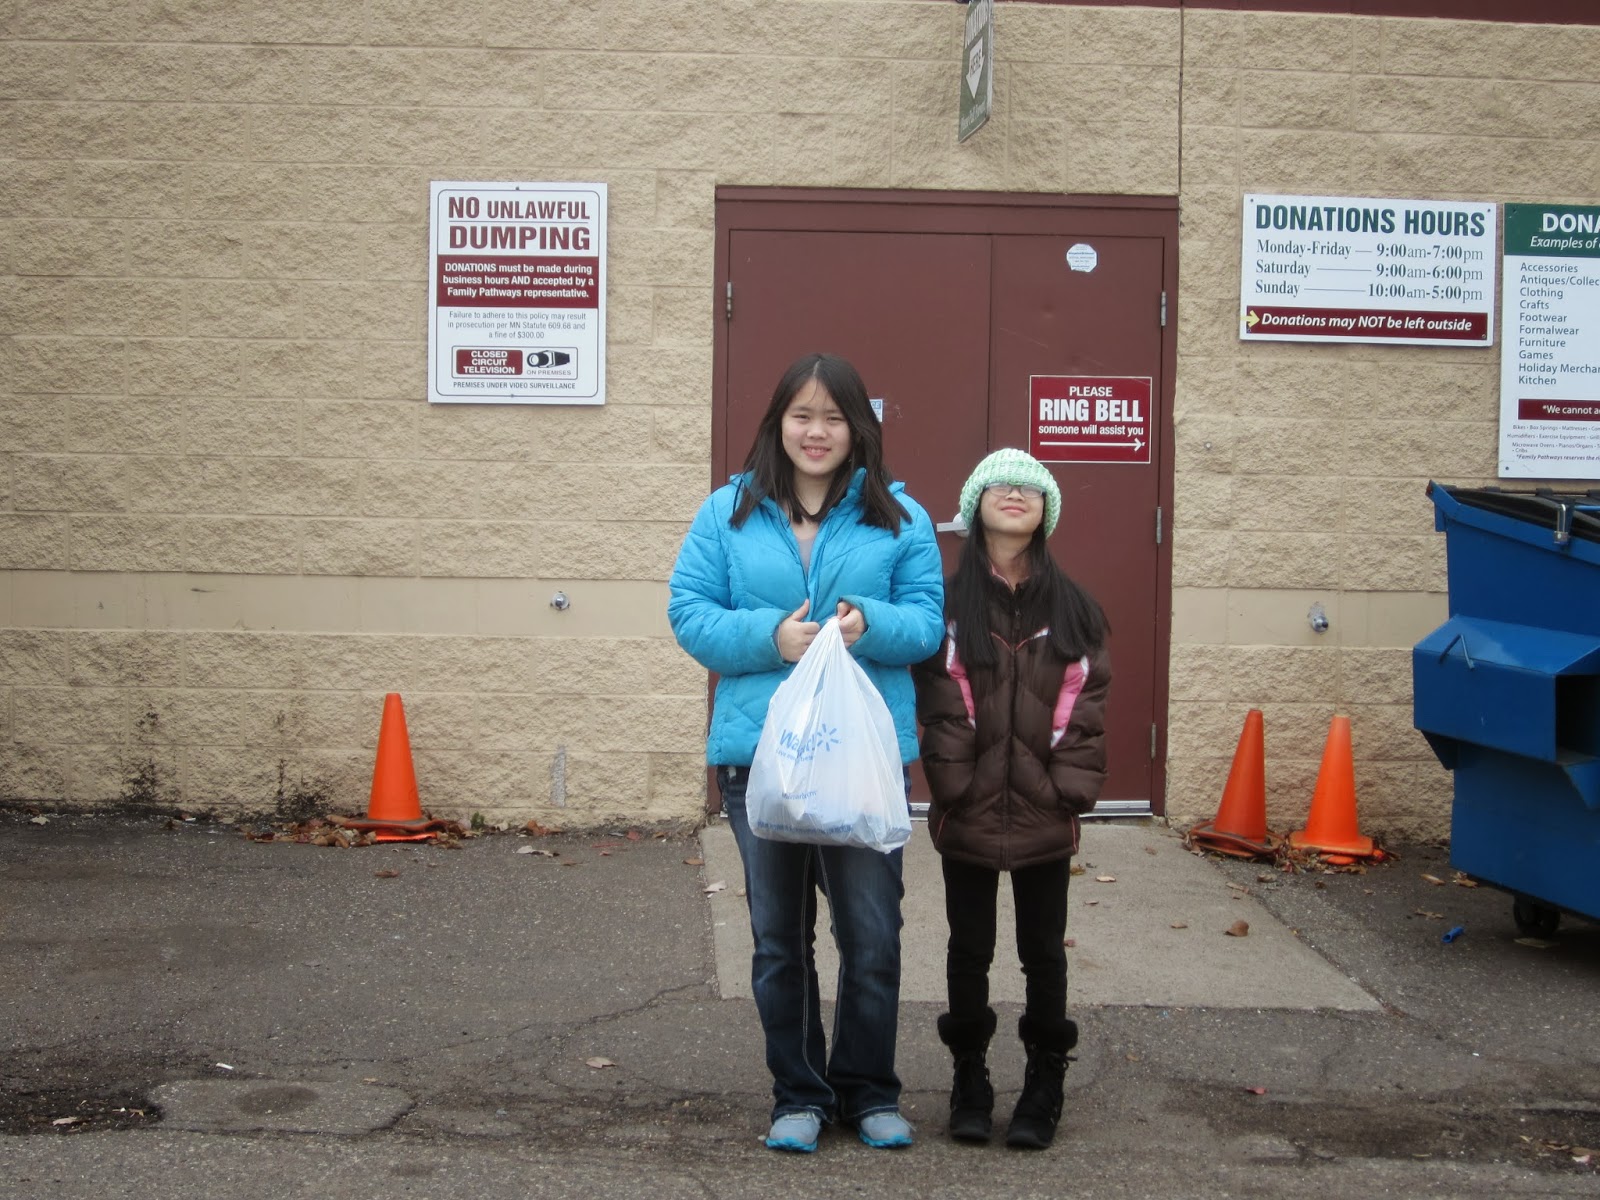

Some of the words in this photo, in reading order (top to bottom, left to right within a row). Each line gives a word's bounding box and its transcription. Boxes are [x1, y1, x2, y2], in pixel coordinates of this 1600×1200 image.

[448, 197, 480, 219] NO
[487, 201, 590, 220] UNLAWFUL
[1256, 204, 1396, 234] DONATIONS
[1404, 209, 1485, 237] HOURS
[449, 225, 590, 250] DUMPING
[1530, 236, 1583, 250] Examples
[1585, 237, 1599, 249] of
[1256, 239, 1352, 259] Monday-Friday
[1376, 243, 1483, 263] 9:00am-7:00pm
[445, 263, 496, 272] DONATIONS
[499, 264, 521, 273] must
[523, 264, 534, 273] be
[537, 264, 561, 273] made
[564, 264, 592, 275] during
[1256, 259, 1311, 278] Saturday
[1376, 263, 1483, 283] 9:00am-6:00pm
[1520, 262, 1578, 273] Accessories
[443, 275, 482, 284] business
[484, 275, 509, 285] hours
[511, 276, 530, 285] AND
[533, 276, 573, 287] accepted
[575, 276, 586, 287] by
[588, 278, 594, 286] a
[448, 287, 477, 298] Family
[479, 288, 522, 298] Pathways
[524, 288, 589, 299] representative.
[1255, 279, 1300, 298] Sunday
[1368, 283, 1483, 304] 10:00am-5:00pm
[1520, 287, 1563, 300] Clothing
[1520, 300, 1549, 310] Crafts
[450, 311, 472, 319] Failure
[530, 312, 548, 321] policy
[567, 312, 586, 320] result
[1262, 313, 1326, 327] Donations
[1328, 316, 1356, 330] may
[1358, 316, 1386, 328] NOT
[1387, 316, 1402, 328] be
[1404, 317, 1425, 329] left
[1427, 319, 1472, 331] outside
[1520, 312, 1567, 323] Footwear
[456, 322, 494, 330] prosecution
[573, 322, 585, 330] and
[1519, 325, 1579, 335] Formalwear
[518, 331, 544, 339] $300.00
[1519, 337, 1566, 347] Furniture
[1519, 350, 1554, 360] Games
[463, 366, 516, 374] TELEVISION
[1519, 363, 1557, 375] Holiday
[1519, 375, 1557, 385] Kitchen
[1069, 386, 1112, 397] PLEASE
[1040, 398, 1089, 421] RING
[1096, 400, 1144, 422] BELL
[1038, 425, 1079, 435] someone
[1081, 424, 1097, 435] will
[1100, 425, 1126, 435] assist
[1127, 427, 1144, 437] you
